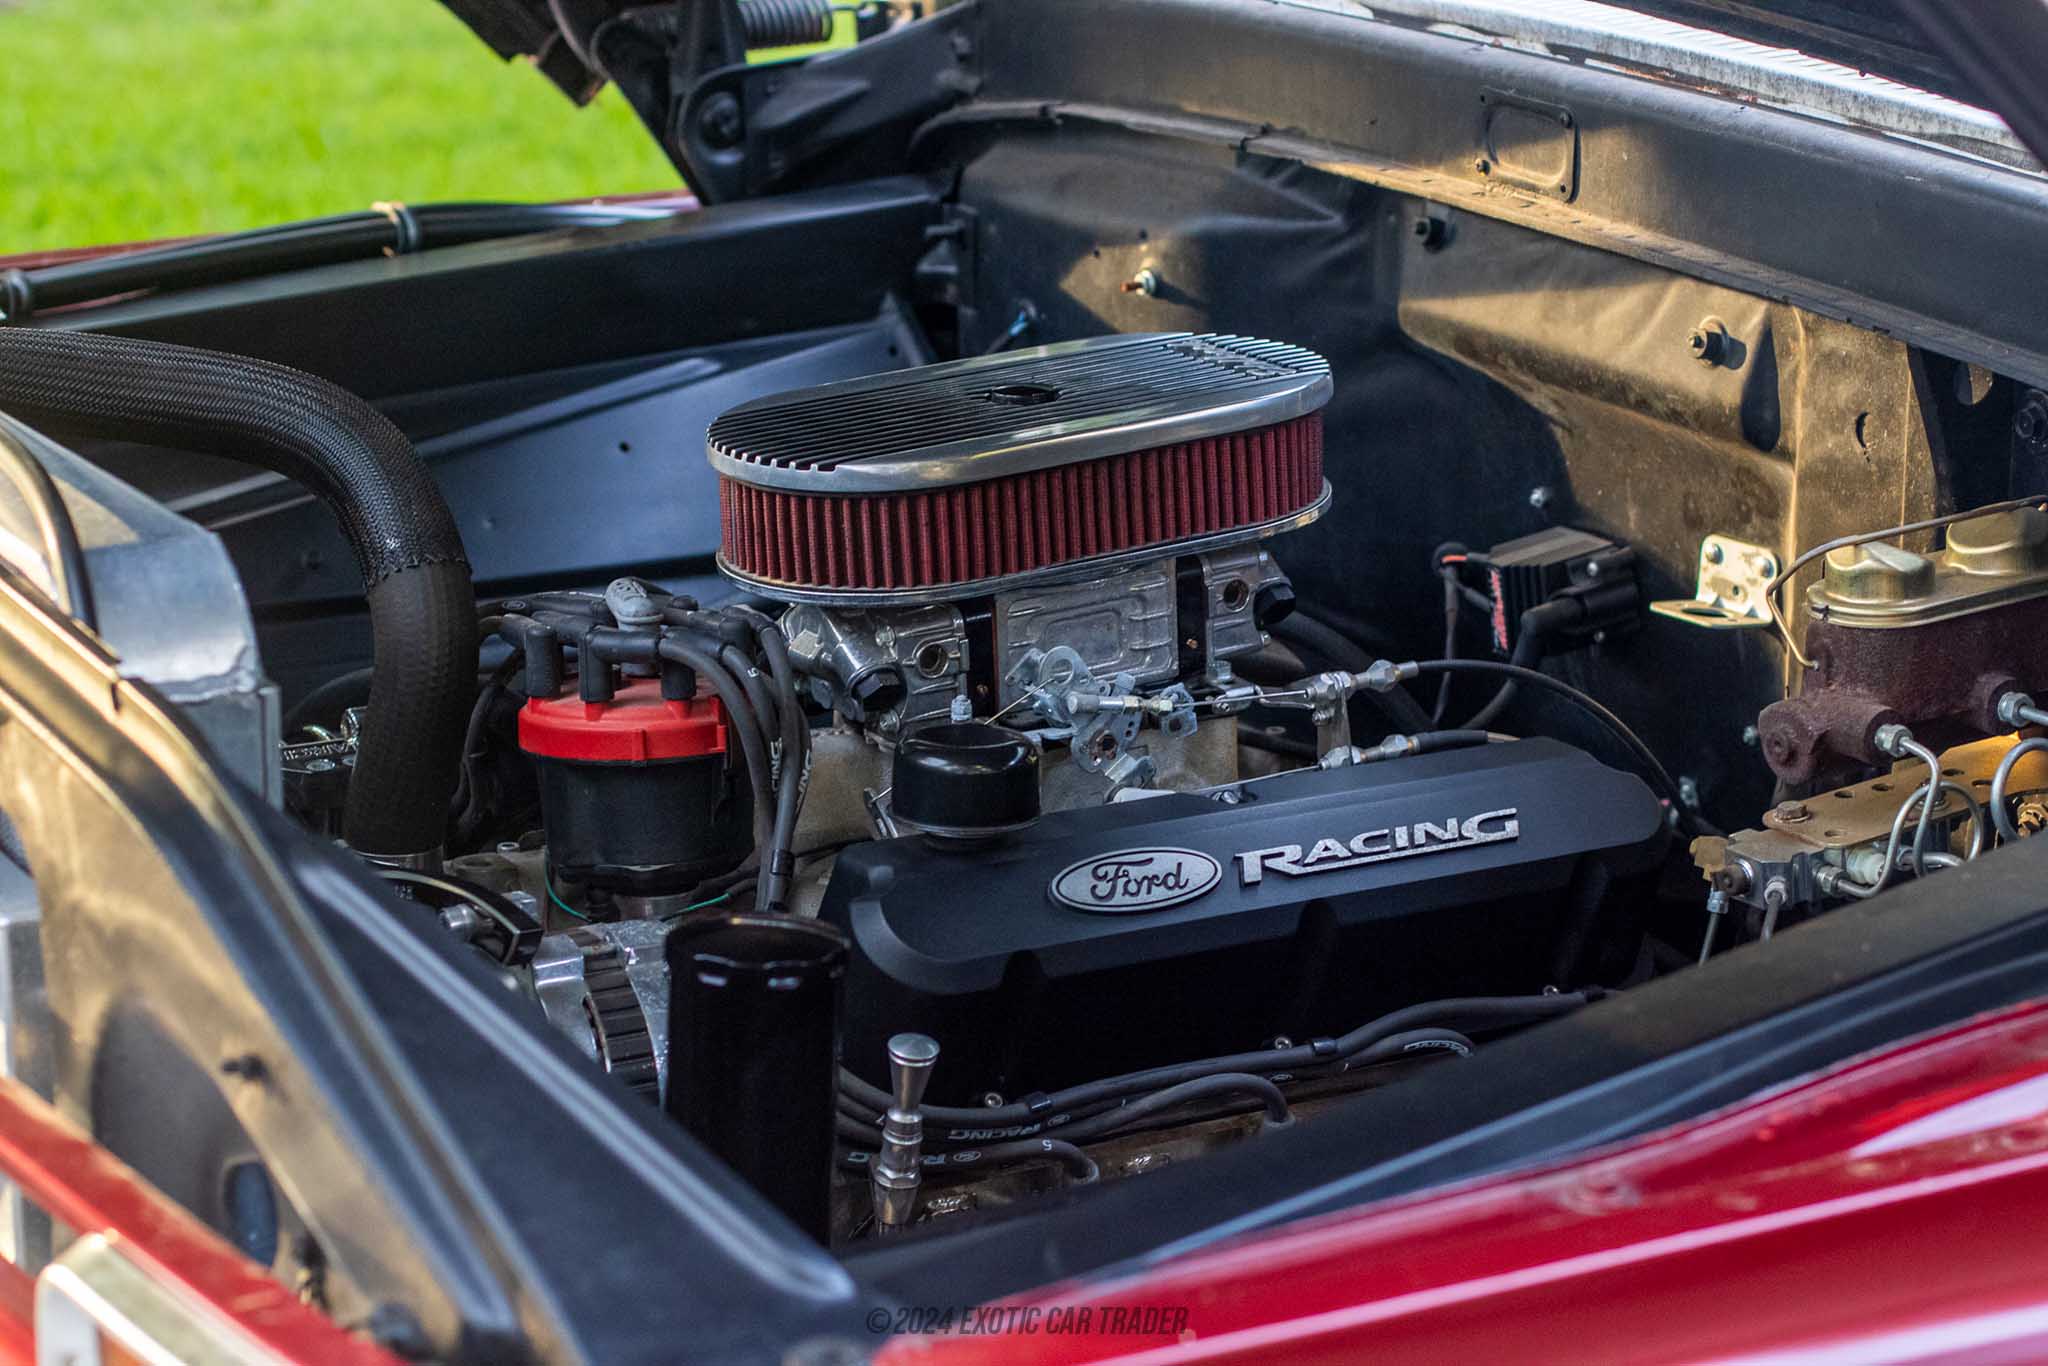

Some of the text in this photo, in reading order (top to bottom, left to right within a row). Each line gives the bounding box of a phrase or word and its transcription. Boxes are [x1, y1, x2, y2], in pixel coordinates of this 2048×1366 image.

[1090, 807, 1520, 902] Ford RACING
[1041, 1138, 1053, 1151] 5
